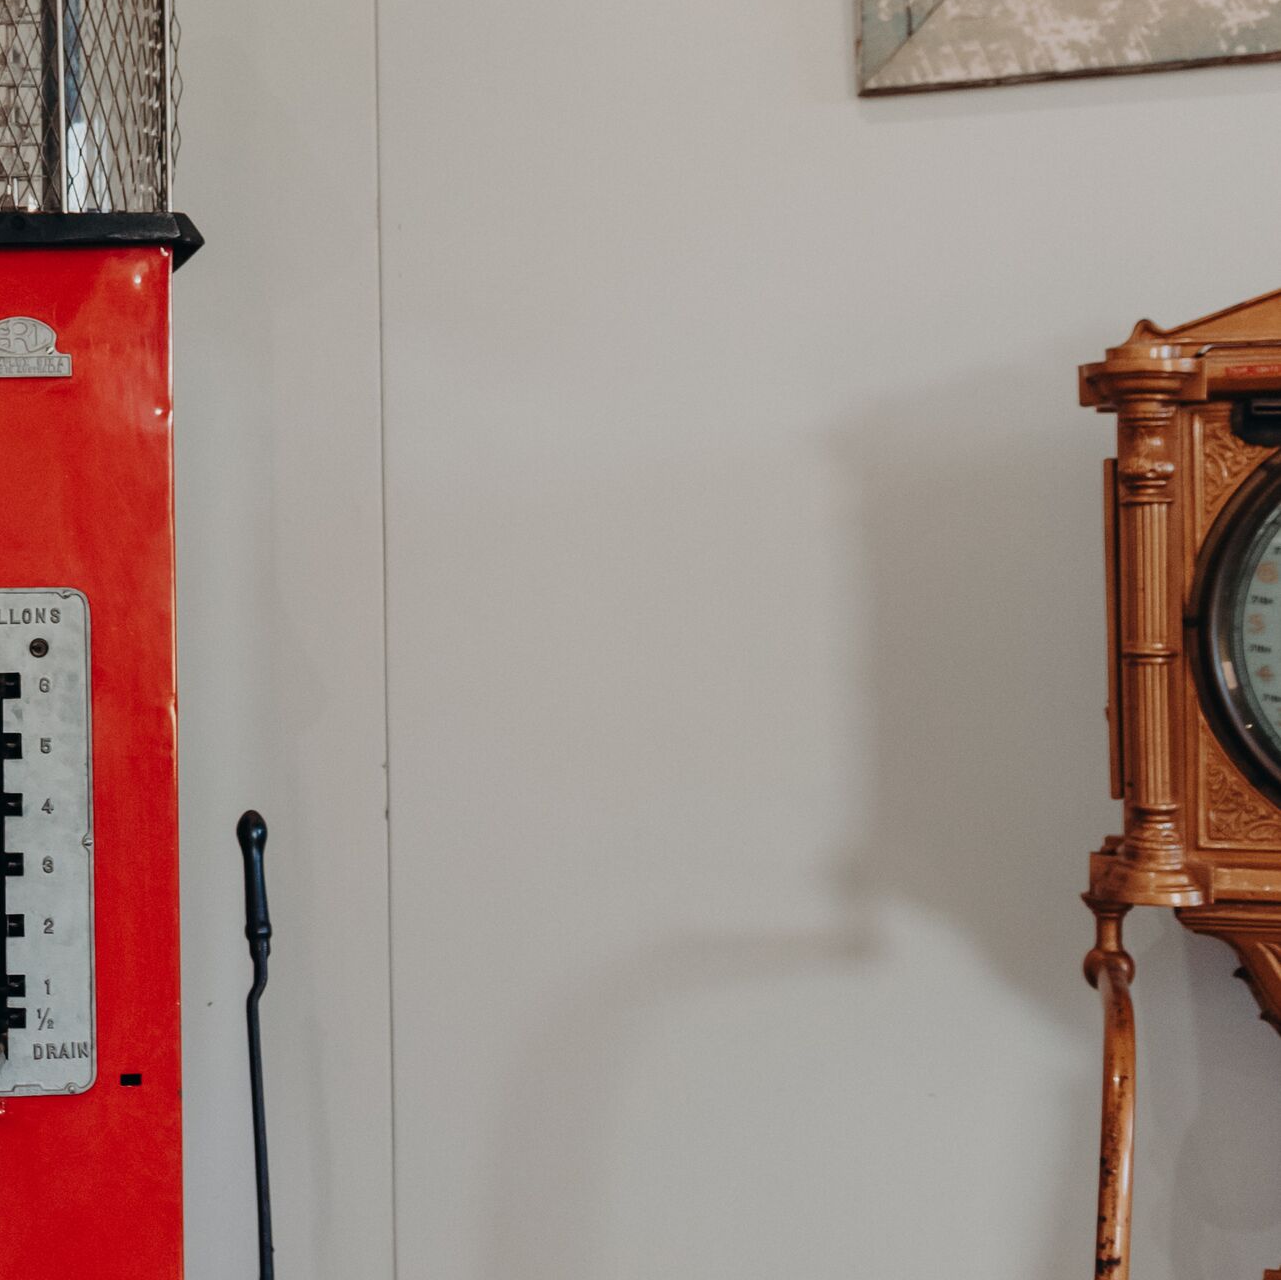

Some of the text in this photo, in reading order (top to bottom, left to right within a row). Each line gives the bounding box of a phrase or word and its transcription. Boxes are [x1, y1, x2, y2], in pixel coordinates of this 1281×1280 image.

[39, 677, 50, 694] 6
[40, 737, 52, 754] 5
[41, 798, 54, 814] 4
[42, 856, 54, 873] 3
[43, 918, 54, 934] 2
[44, 979, 51, 995] 1
[32, 1041, 90, 1060] DRAIN
